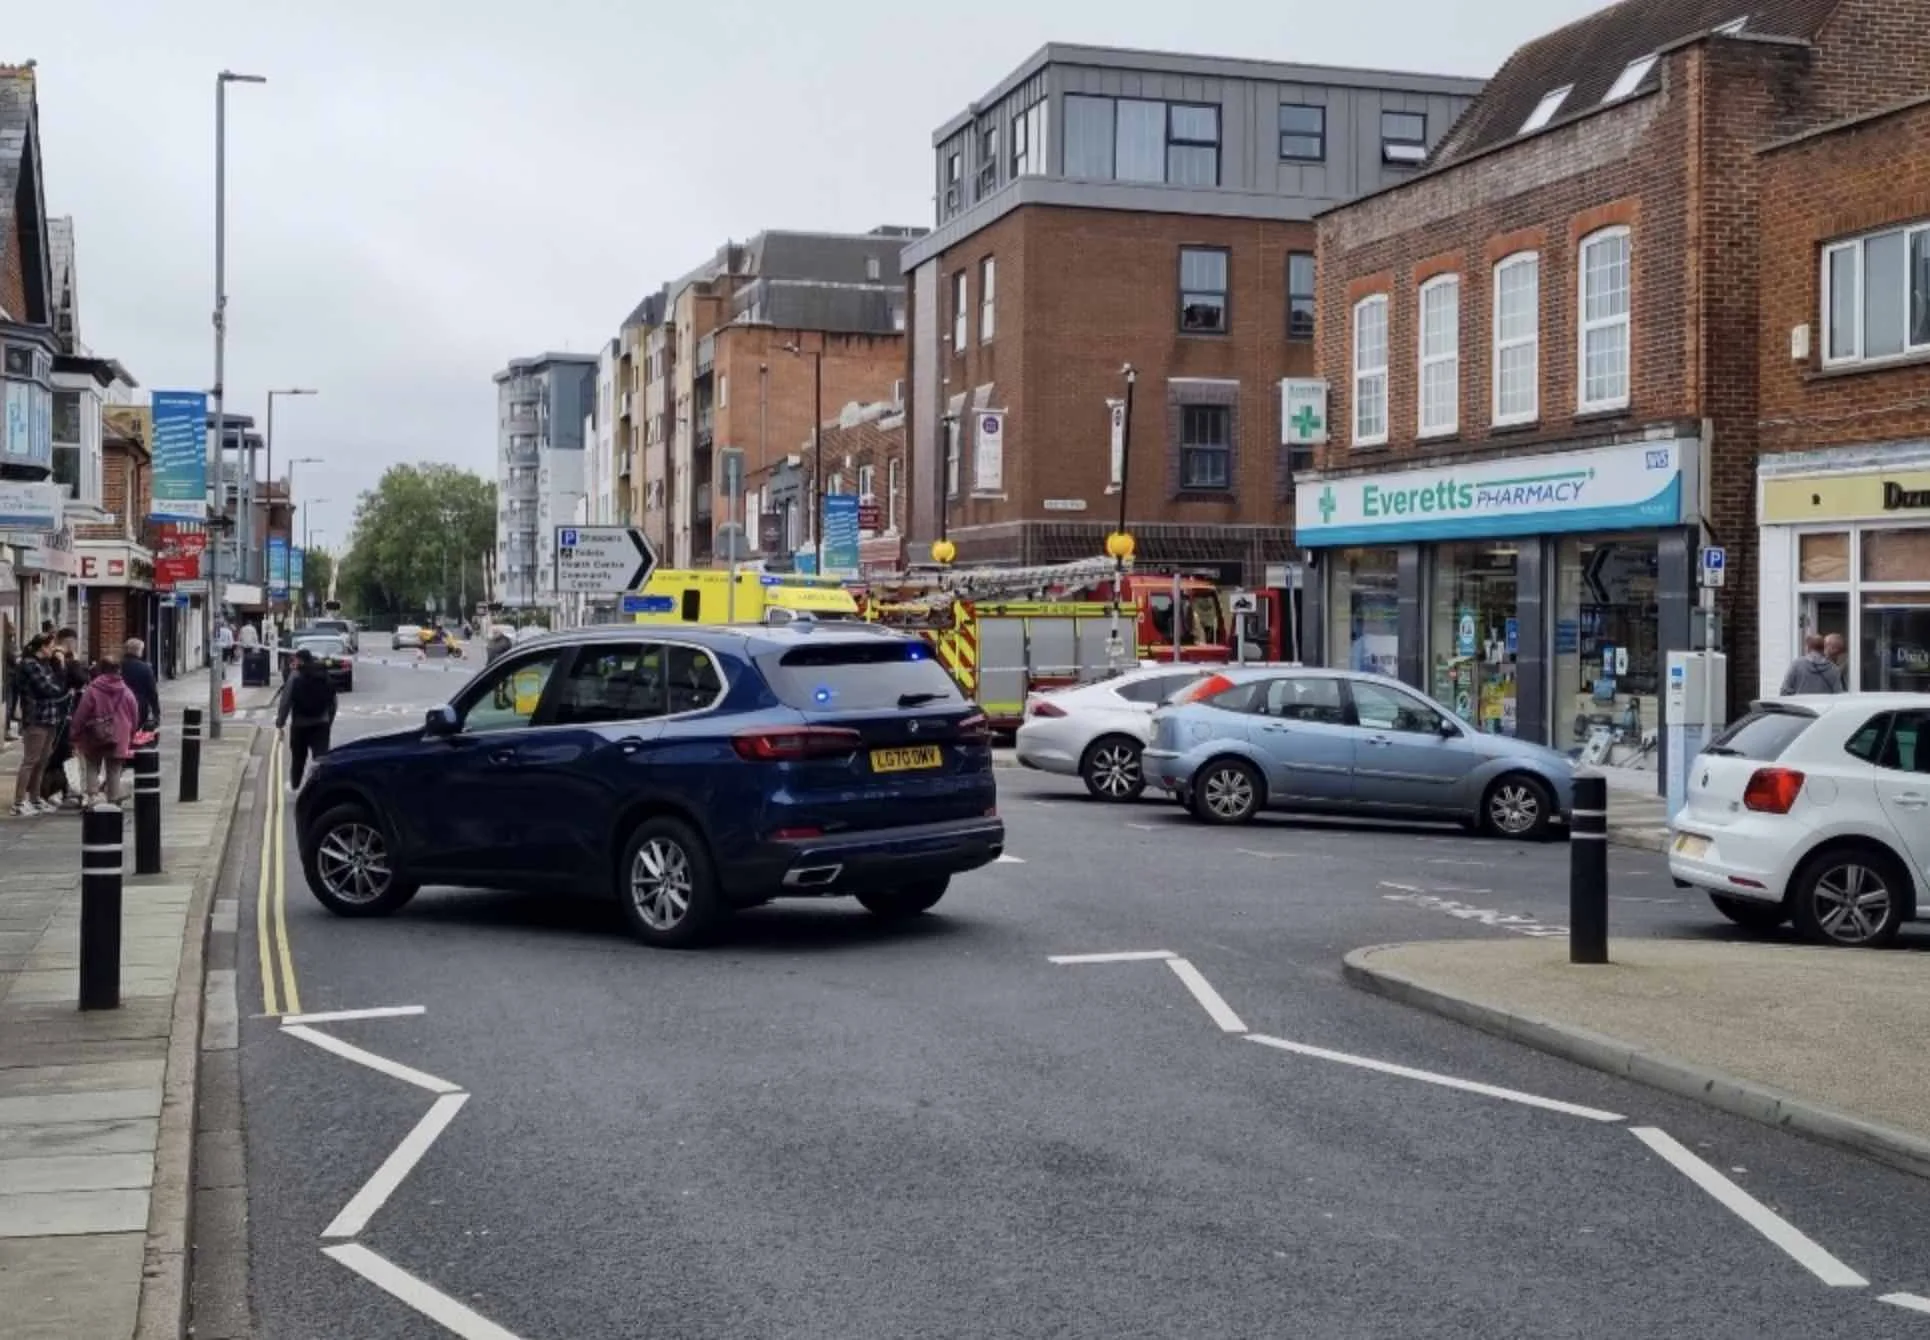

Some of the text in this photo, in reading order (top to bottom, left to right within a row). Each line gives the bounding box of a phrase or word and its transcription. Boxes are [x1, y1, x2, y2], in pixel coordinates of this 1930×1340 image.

[1363, 479, 1586, 517] Everetts PHARMACY
[1710, 551, 1721, 567] P
